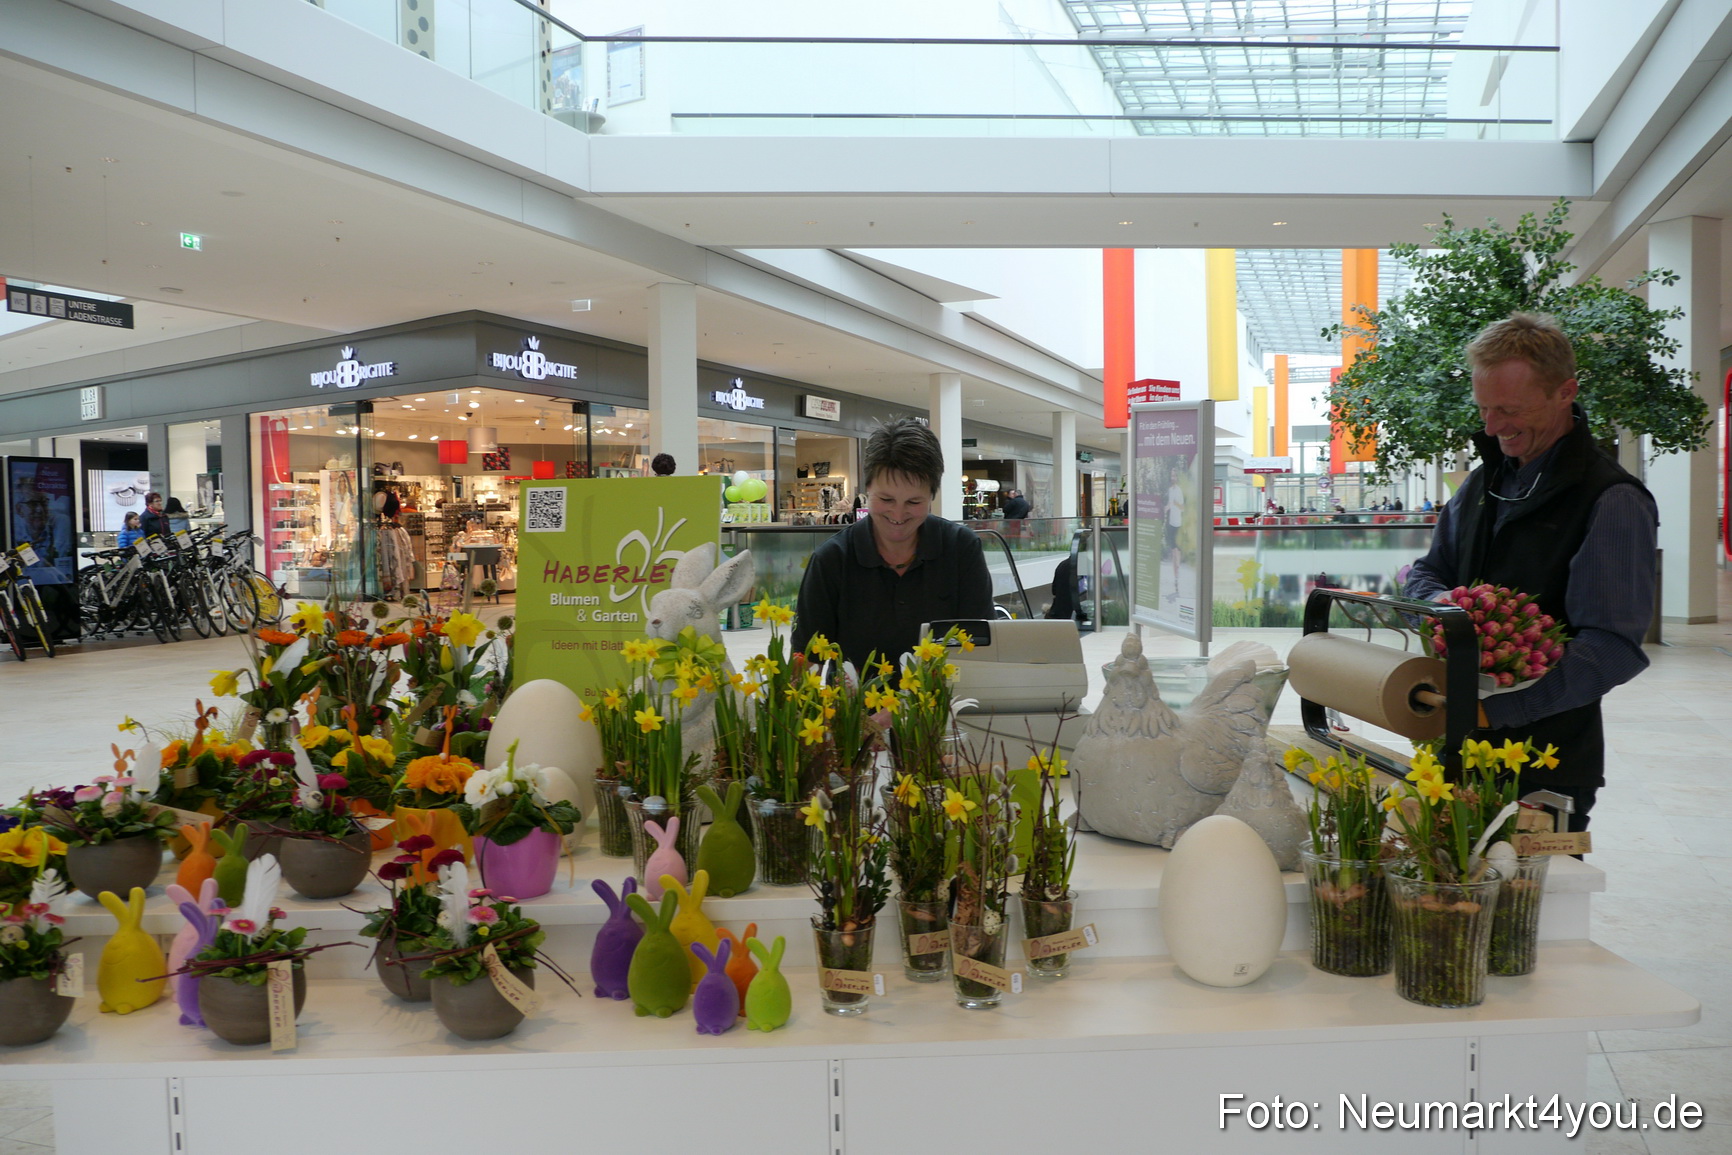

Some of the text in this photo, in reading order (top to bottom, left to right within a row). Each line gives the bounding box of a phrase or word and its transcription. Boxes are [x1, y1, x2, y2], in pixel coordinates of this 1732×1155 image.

[67, 300, 97, 312] UNTERE
[68, 311, 123, 326] LADENSTRASSE
[493, 352, 522, 371] BIJOU
[310, 370, 336, 388] BIJOU
[1155, 433, 1170, 446] dem
[1171, 432, 1195, 445] Neuen.
[550, 593, 600, 606] Blumen
[577, 609, 638, 622] & Garten
[551, 640, 624, 651] Ideen mit Blatt
